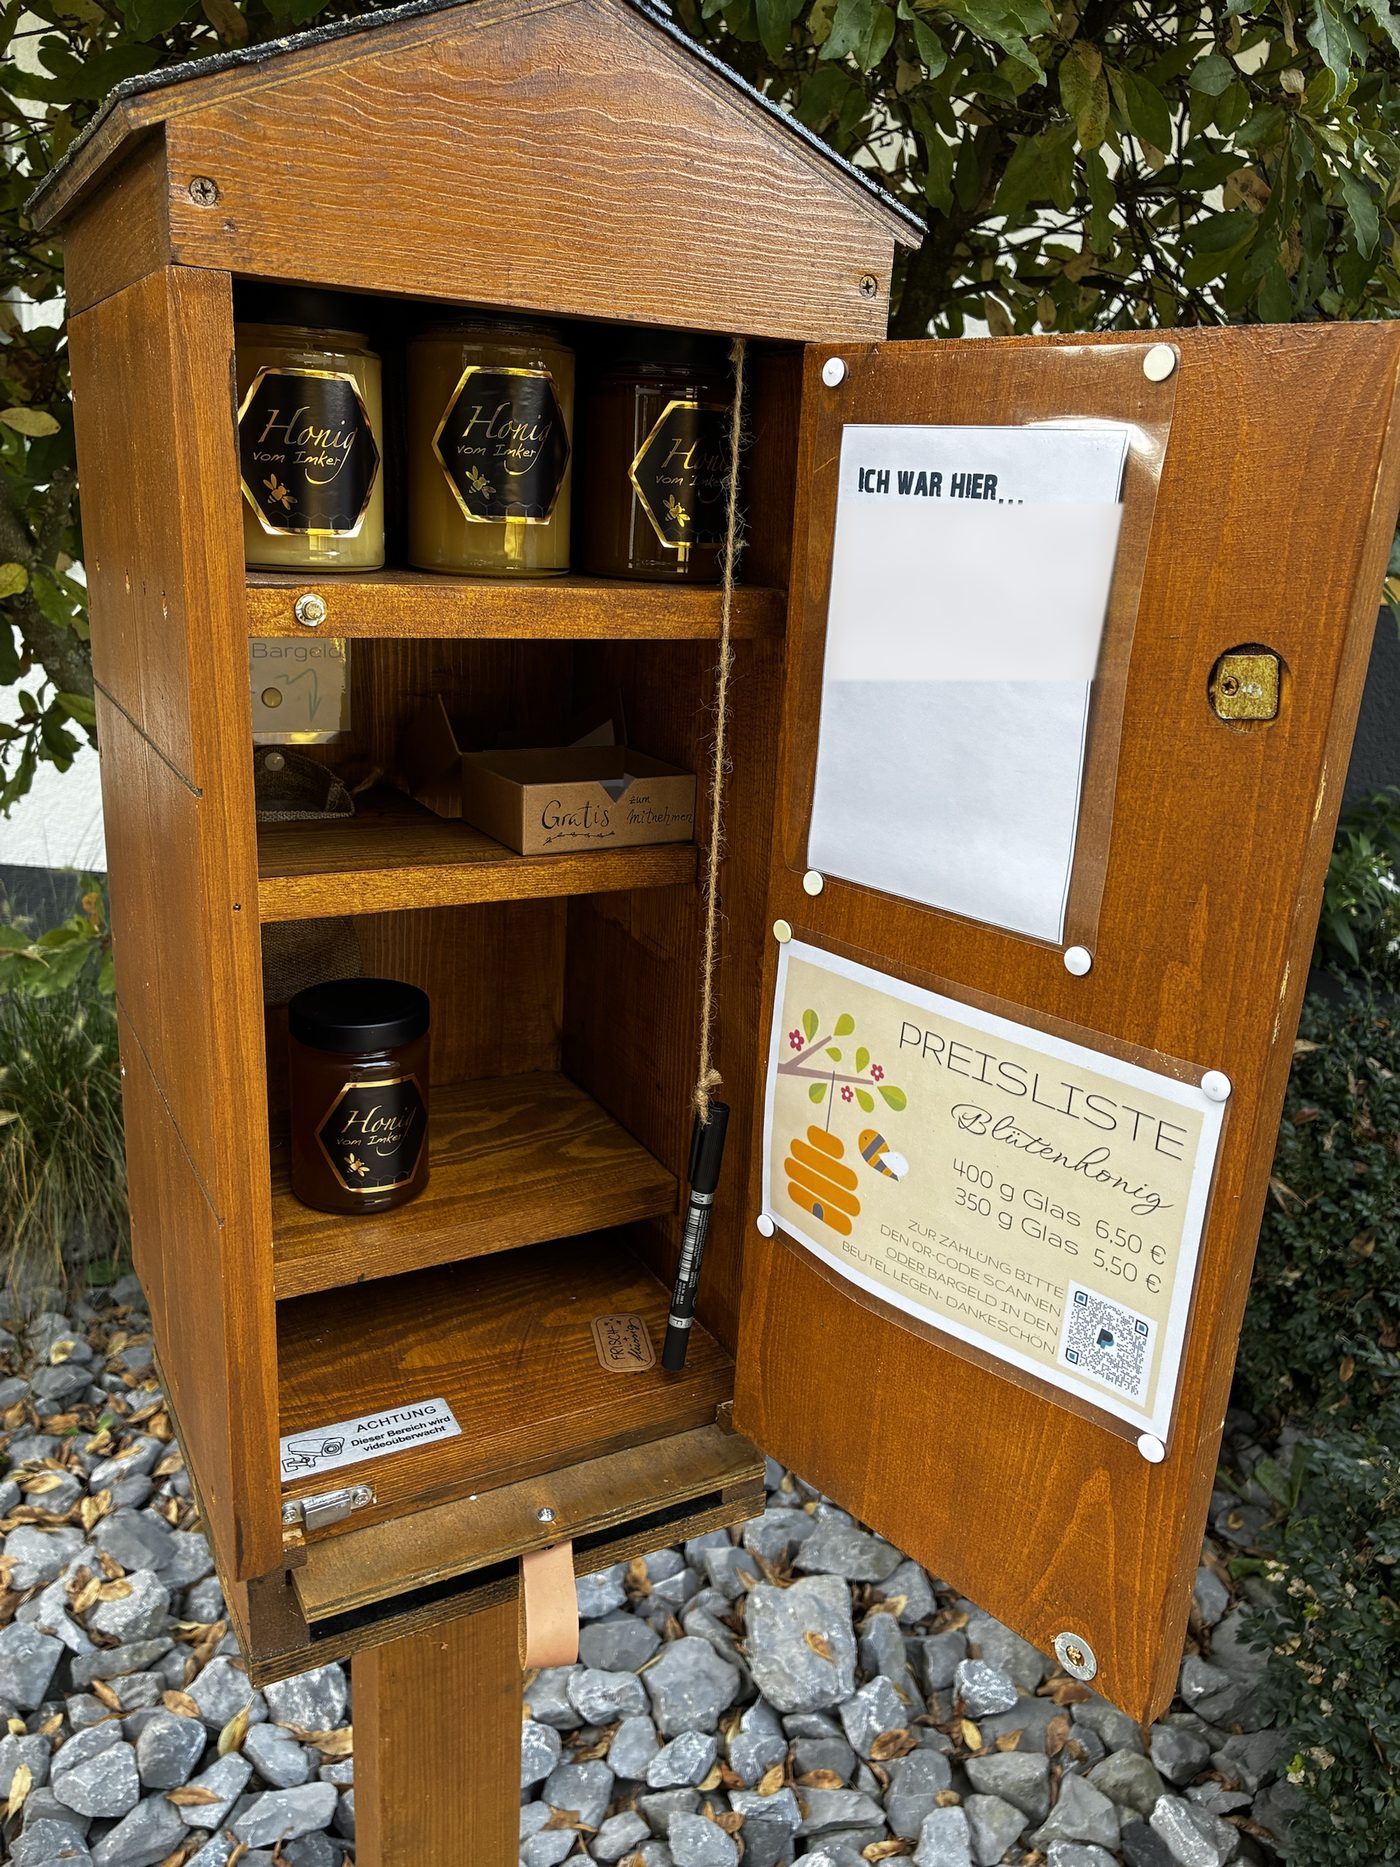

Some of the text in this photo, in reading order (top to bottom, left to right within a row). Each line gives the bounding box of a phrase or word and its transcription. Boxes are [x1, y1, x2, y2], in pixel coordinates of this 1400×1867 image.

[258, 406, 358, 485] Honig
[457, 443, 537, 459] vom Imker
[462, 401, 552, 476] Honig
[253, 450, 341, 467] vom Imker
[655, 475, 684, 486] vom
[858, 467, 891, 494] ICH
[897, 470, 943, 497] WAR
[541, 800, 611, 830] Gratis
[899, 1021, 1188, 1161] PREISLISTE
[951, 1103, 1174, 1216] Blütenhonig
[953, 1158, 994, 1189] 400
[999, 1183, 1015, 1202] g
[1023, 1189, 1081, 1227] Glas
[1150, 1245, 1167, 1265] €
[842, 1240, 891, 1276] BEUTEL
[954, 1187, 991, 1216] 350
[998, 1211, 1013, 1230] g
[1021, 1217, 1079, 1256] Glas
[1145, 1273, 1162, 1294] €
[880, 1223, 1061, 1317] DEN QR-CODE SCANNEN
[908, 1219, 1064, 1299] ZUR ZAHLUNG BITTE
[886, 1247, 1058, 1336] ODER BARGELD IN DEN
[607, 1325, 626, 1360] FRISCH
[350, 1415, 451, 1447] Dieser Bereich wird
[356, 1405, 437, 1433] ACHTUNG
[363, 1425, 447, 1452] videoüberwacht
